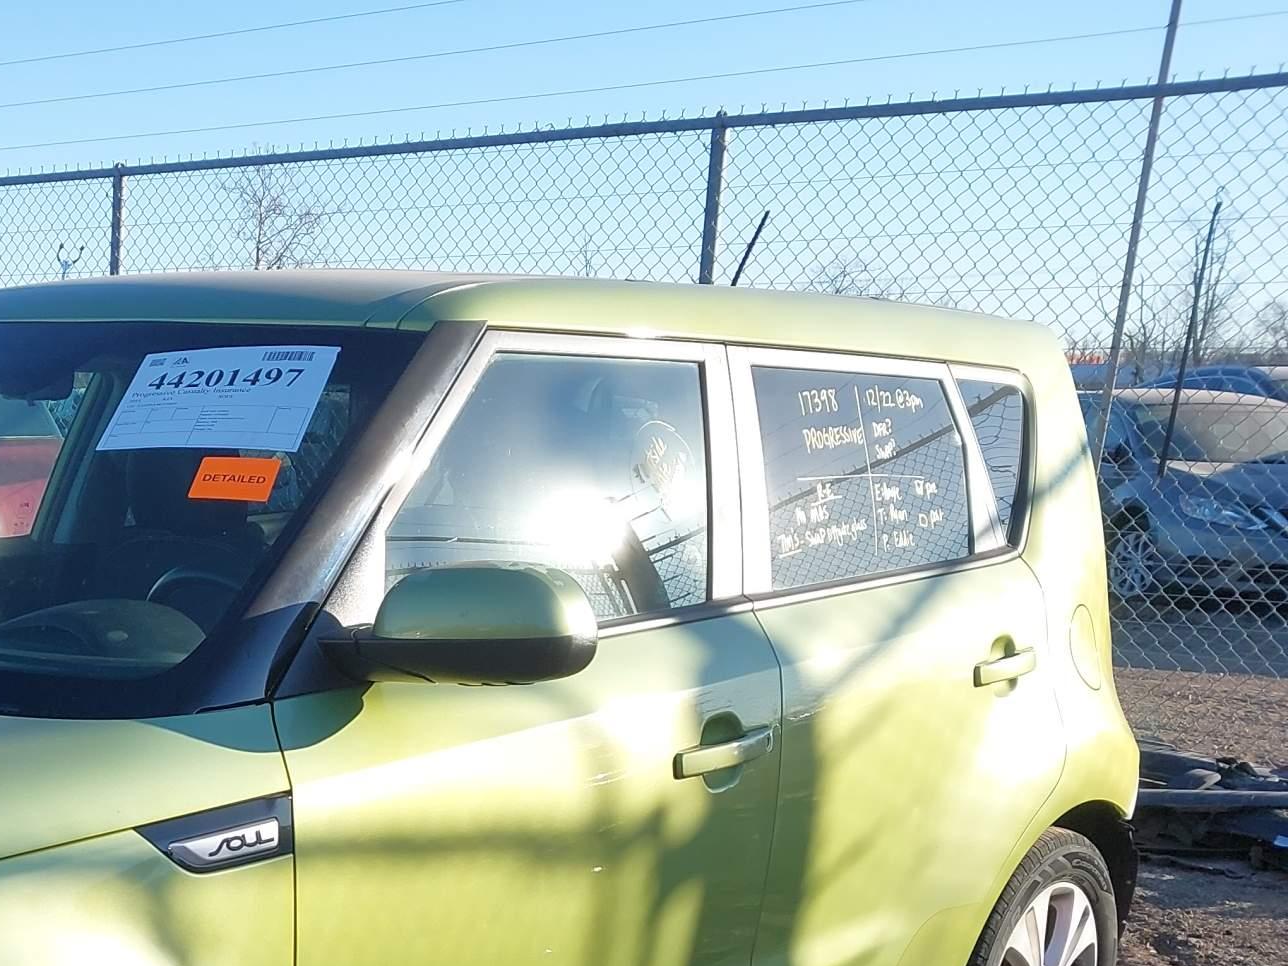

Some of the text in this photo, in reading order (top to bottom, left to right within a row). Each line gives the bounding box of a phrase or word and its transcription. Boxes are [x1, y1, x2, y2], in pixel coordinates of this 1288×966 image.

[148, 366, 305, 391] 44201497
[131, 387, 252, 399] Progressive Casualty Insurance
[798, 389, 838, 416] 17398
[803, 423, 864, 455] PROGRESSIVE
[202, 473, 266, 485] DETAILED
[207, 828, 275, 857] SOUL
